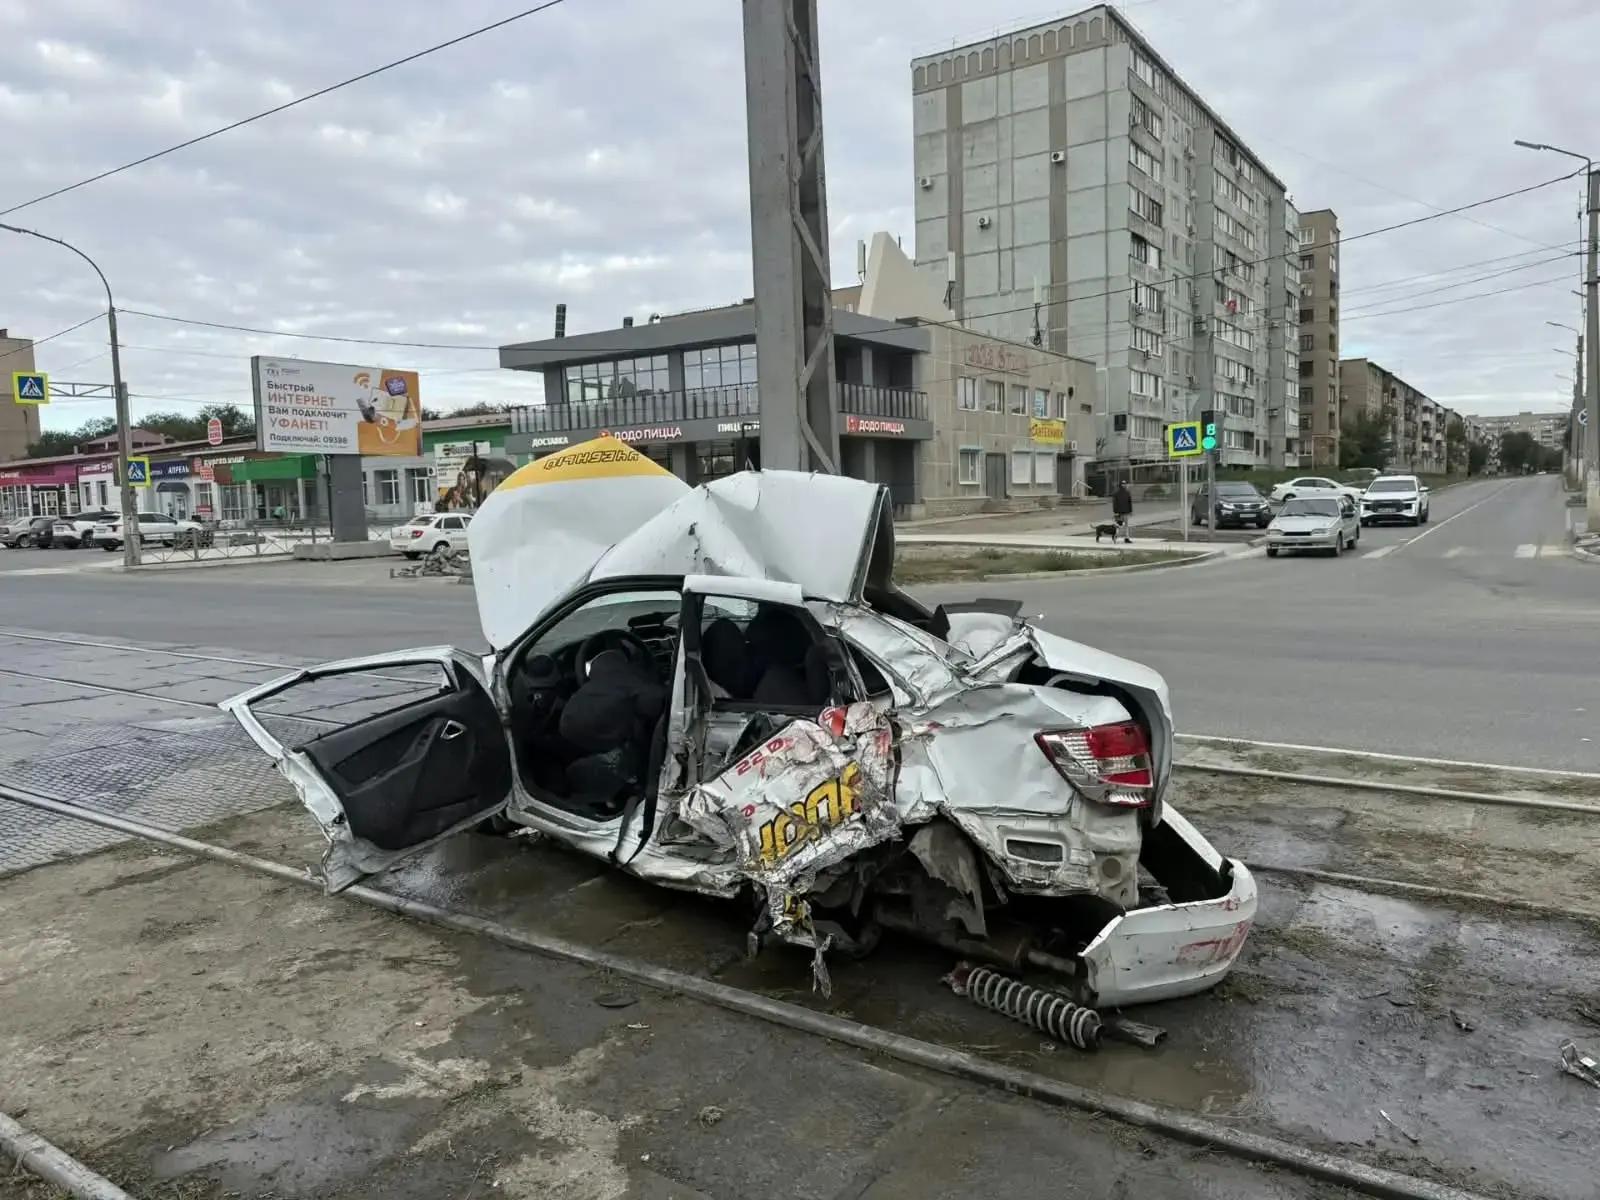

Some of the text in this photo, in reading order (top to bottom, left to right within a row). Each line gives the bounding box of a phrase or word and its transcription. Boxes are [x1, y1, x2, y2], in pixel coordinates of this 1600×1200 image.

[266, 380, 315, 393] Быстрый
[268, 392, 336, 407] ИНТЕРНЕТ
[268, 405, 347, 419] Вам подключит
[269, 417, 328, 430] УФАНЕТ!
[859, 419, 905, 435] ДОДО ПИЦЦА
[269, 433, 321, 443] Подключай:
[614, 427, 682, 442] ДОДО ПИЦЦА
[532, 436, 569, 448] ДОСТАВКА
[543, 449, 640, 471] УЧЕБНЫЙ
[168, 465, 190, 474] АПРЕЛЬ
